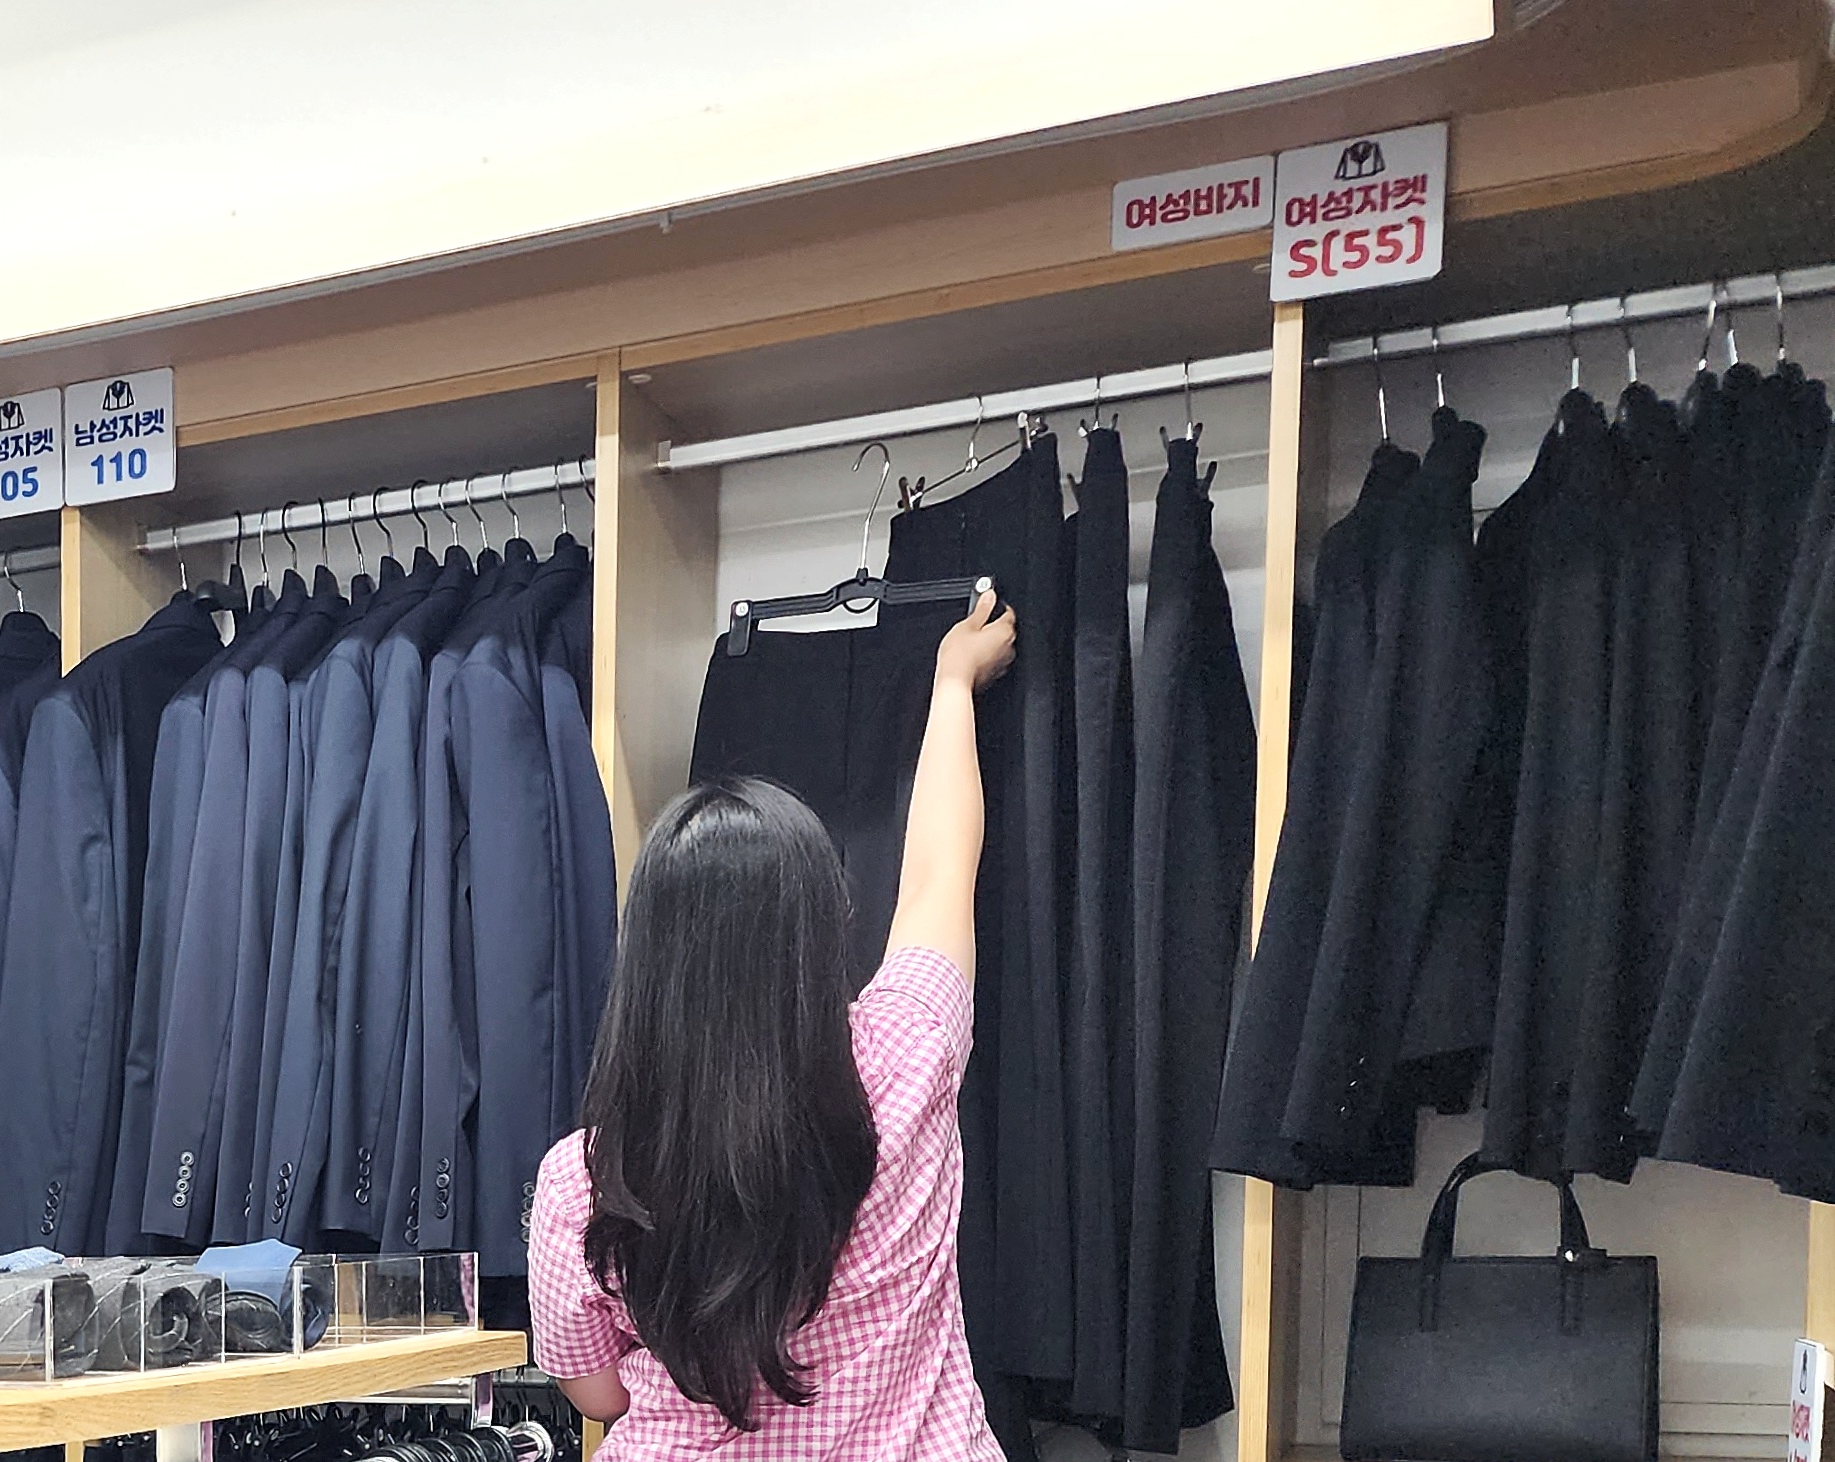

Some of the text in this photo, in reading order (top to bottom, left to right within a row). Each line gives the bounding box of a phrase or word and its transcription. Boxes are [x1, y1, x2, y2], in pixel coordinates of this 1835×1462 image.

[1126, 177, 1261, 229] 여성바지
[1285, 174, 1428, 227] 여성자켓
[1288, 216, 1426, 278] S(55)
[74, 408, 164, 446] 남성자켓
[91, 448, 147, 485] 110
